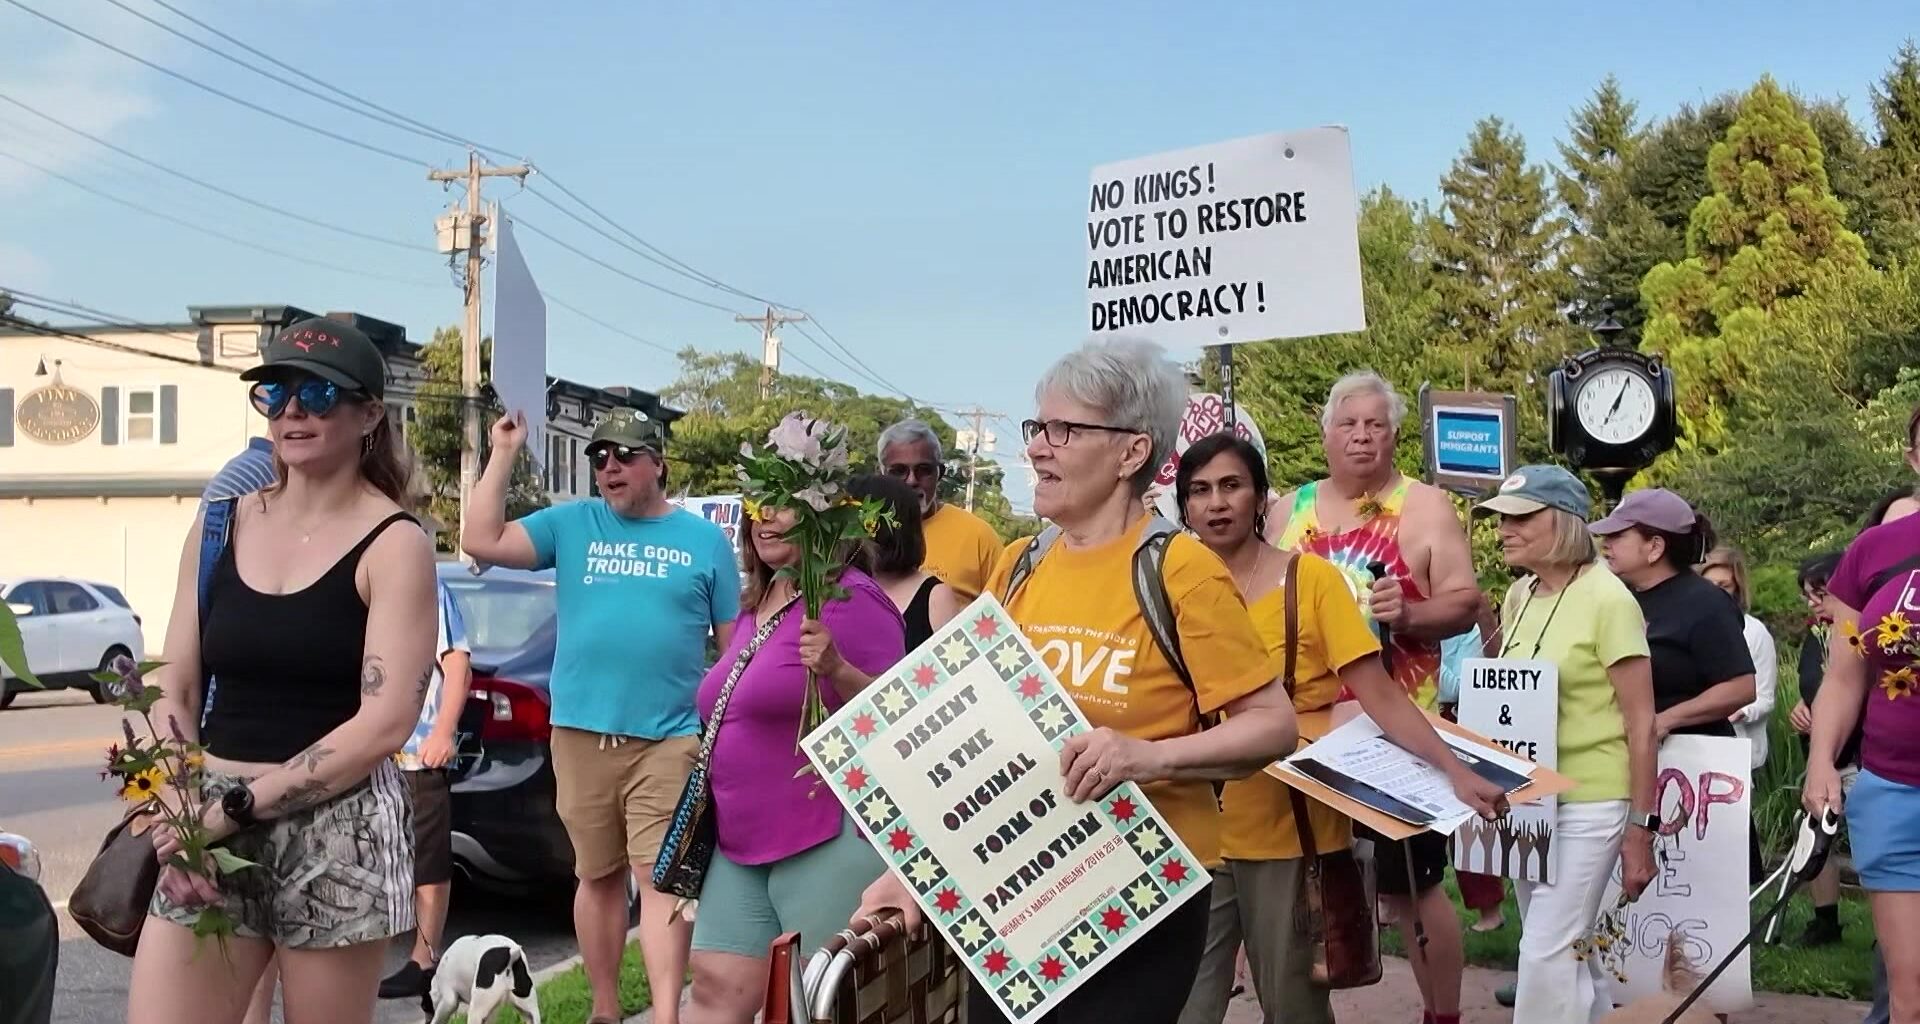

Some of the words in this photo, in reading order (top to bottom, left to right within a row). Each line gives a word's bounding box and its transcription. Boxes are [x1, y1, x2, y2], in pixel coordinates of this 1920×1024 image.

[1090, 180, 1124, 212] NO
[1088, 213, 1145, 250] VOTE
[1153, 208, 1187, 241] TO
[1197, 191, 1306, 234] RESTORE
[1087, 246, 1212, 289] AMERICAN
[1440, 441, 1499, 455] IMMIGRANTS
[1447, 430, 1491, 442] SUPPORT
[587, 557, 669, 578] TROUBLE
[588, 541, 639, 558] MAKE
[644, 545, 692, 566] GOOD
[1068, 625, 1083, 635] ON
[1085, 628, 1104, 639] THE
[1034, 637, 1136, 695] OVE
[1472, 667, 1541, 691] LIBERTY
[893, 684, 978, 761] DISSENT
[1497, 704, 1513, 726] &
[926, 762, 953, 789] IS
[947, 728, 994, 769] THE
[942, 752, 1037, 832] ORIGINAL
[972, 810, 1033, 865] FORM
[1028, 788, 1057, 818] OF
[982, 811, 1103, 915] PATRIOTISM
[1031, 889, 1058, 913] MARCH
